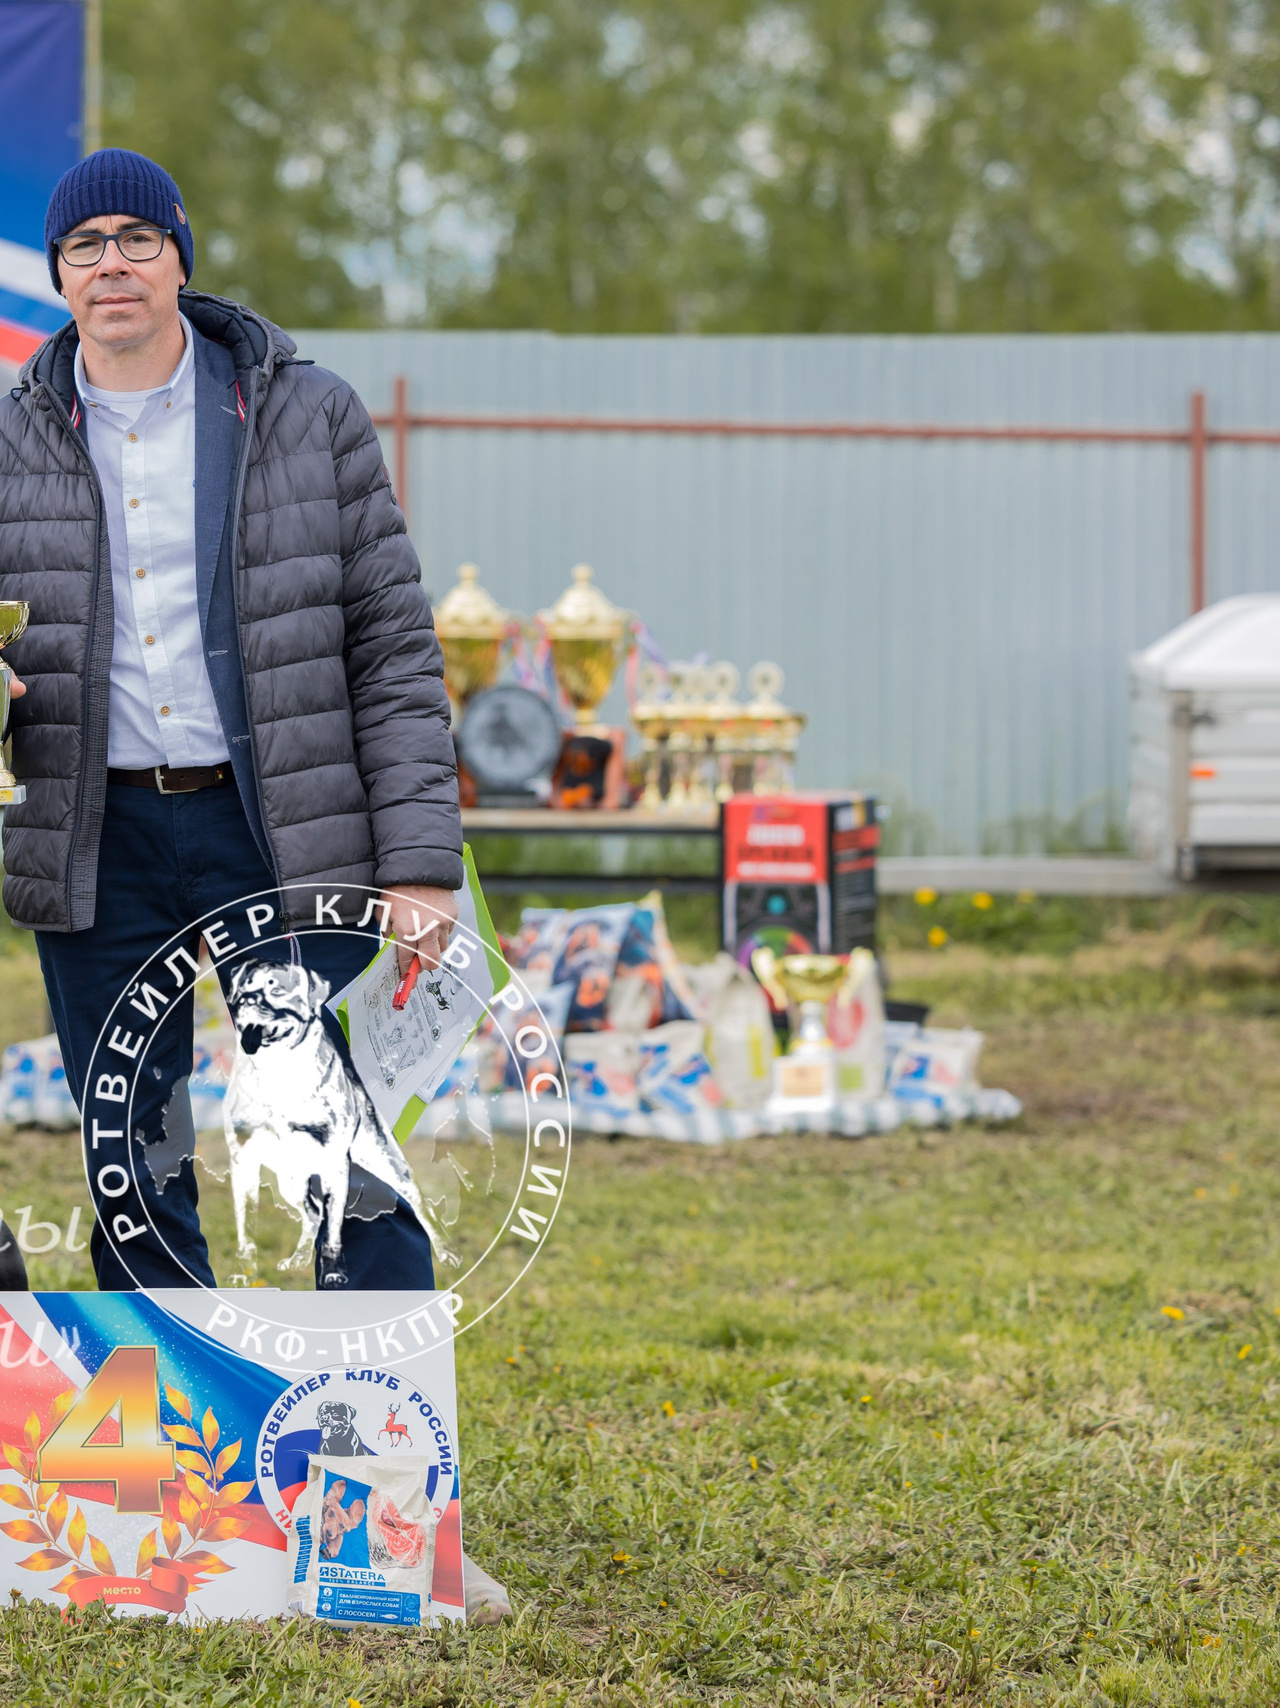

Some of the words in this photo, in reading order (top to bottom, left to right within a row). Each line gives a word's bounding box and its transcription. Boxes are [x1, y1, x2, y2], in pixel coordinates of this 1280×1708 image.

[37, 1345, 177, 1515] 4
[261, 1372, 332, 1478] РОТВЕЙЛЕР
[345, 1368, 401, 1391] КЛУБ
[408, 1391, 453, 1476] РОССИИ
[103, 1586, 142, 1595] место
[344, 1610, 376, 1618] ЛОСОСЕМ
